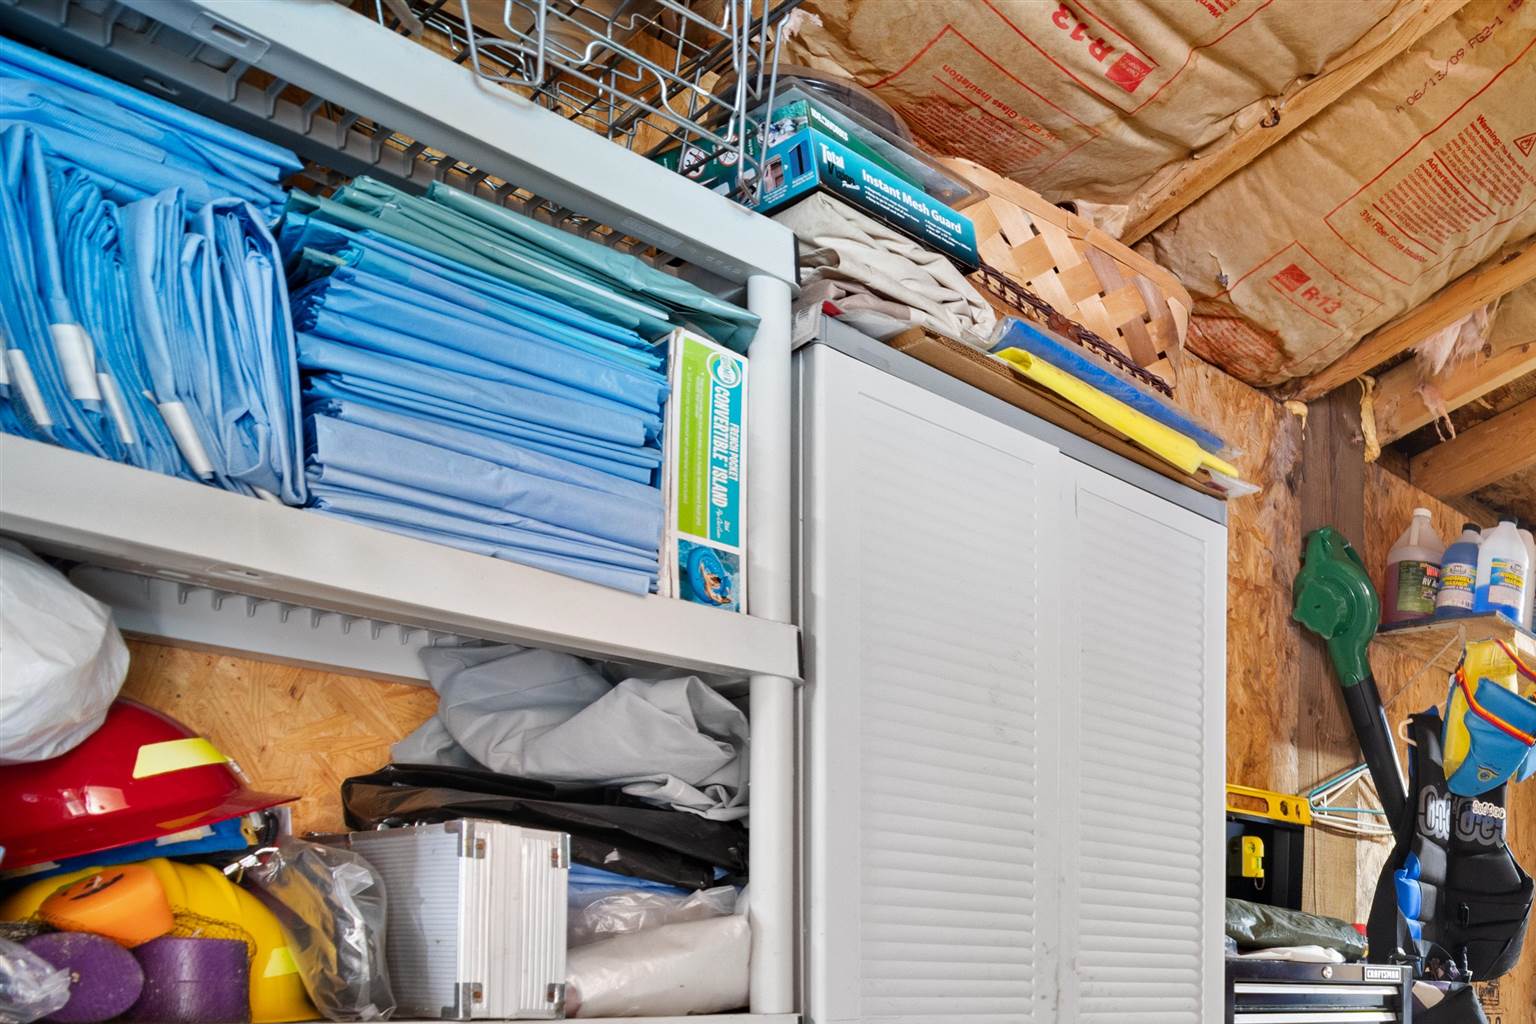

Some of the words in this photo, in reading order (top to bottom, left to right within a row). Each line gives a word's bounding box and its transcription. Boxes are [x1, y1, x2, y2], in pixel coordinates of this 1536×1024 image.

[1047, 1, 1117, 65] R-13
[1406, 48, 1465, 106] 06/13/09
[1467, 15, 1504, 49] FG2-1
[940, 60, 993, 105] Insulation
[990, 95, 1019, 122] Glass
[1473, 113, 1507, 148] Warning:
[819, 142, 846, 169] Total
[861, 168, 901, 201] Instant
[902, 192, 930, 217] Mesh
[930, 208, 963, 235] Guard
[1301, 286, 1344, 316] R-13
[712, 385, 732, 459] CONVERTIBLE
[730, 424, 740, 453] FRENCH
[711, 463, 730, 508] ISLAND
[729, 453, 739, 483] POCKET
[1366, 969, 1400, 981] CRAFTSMAN
